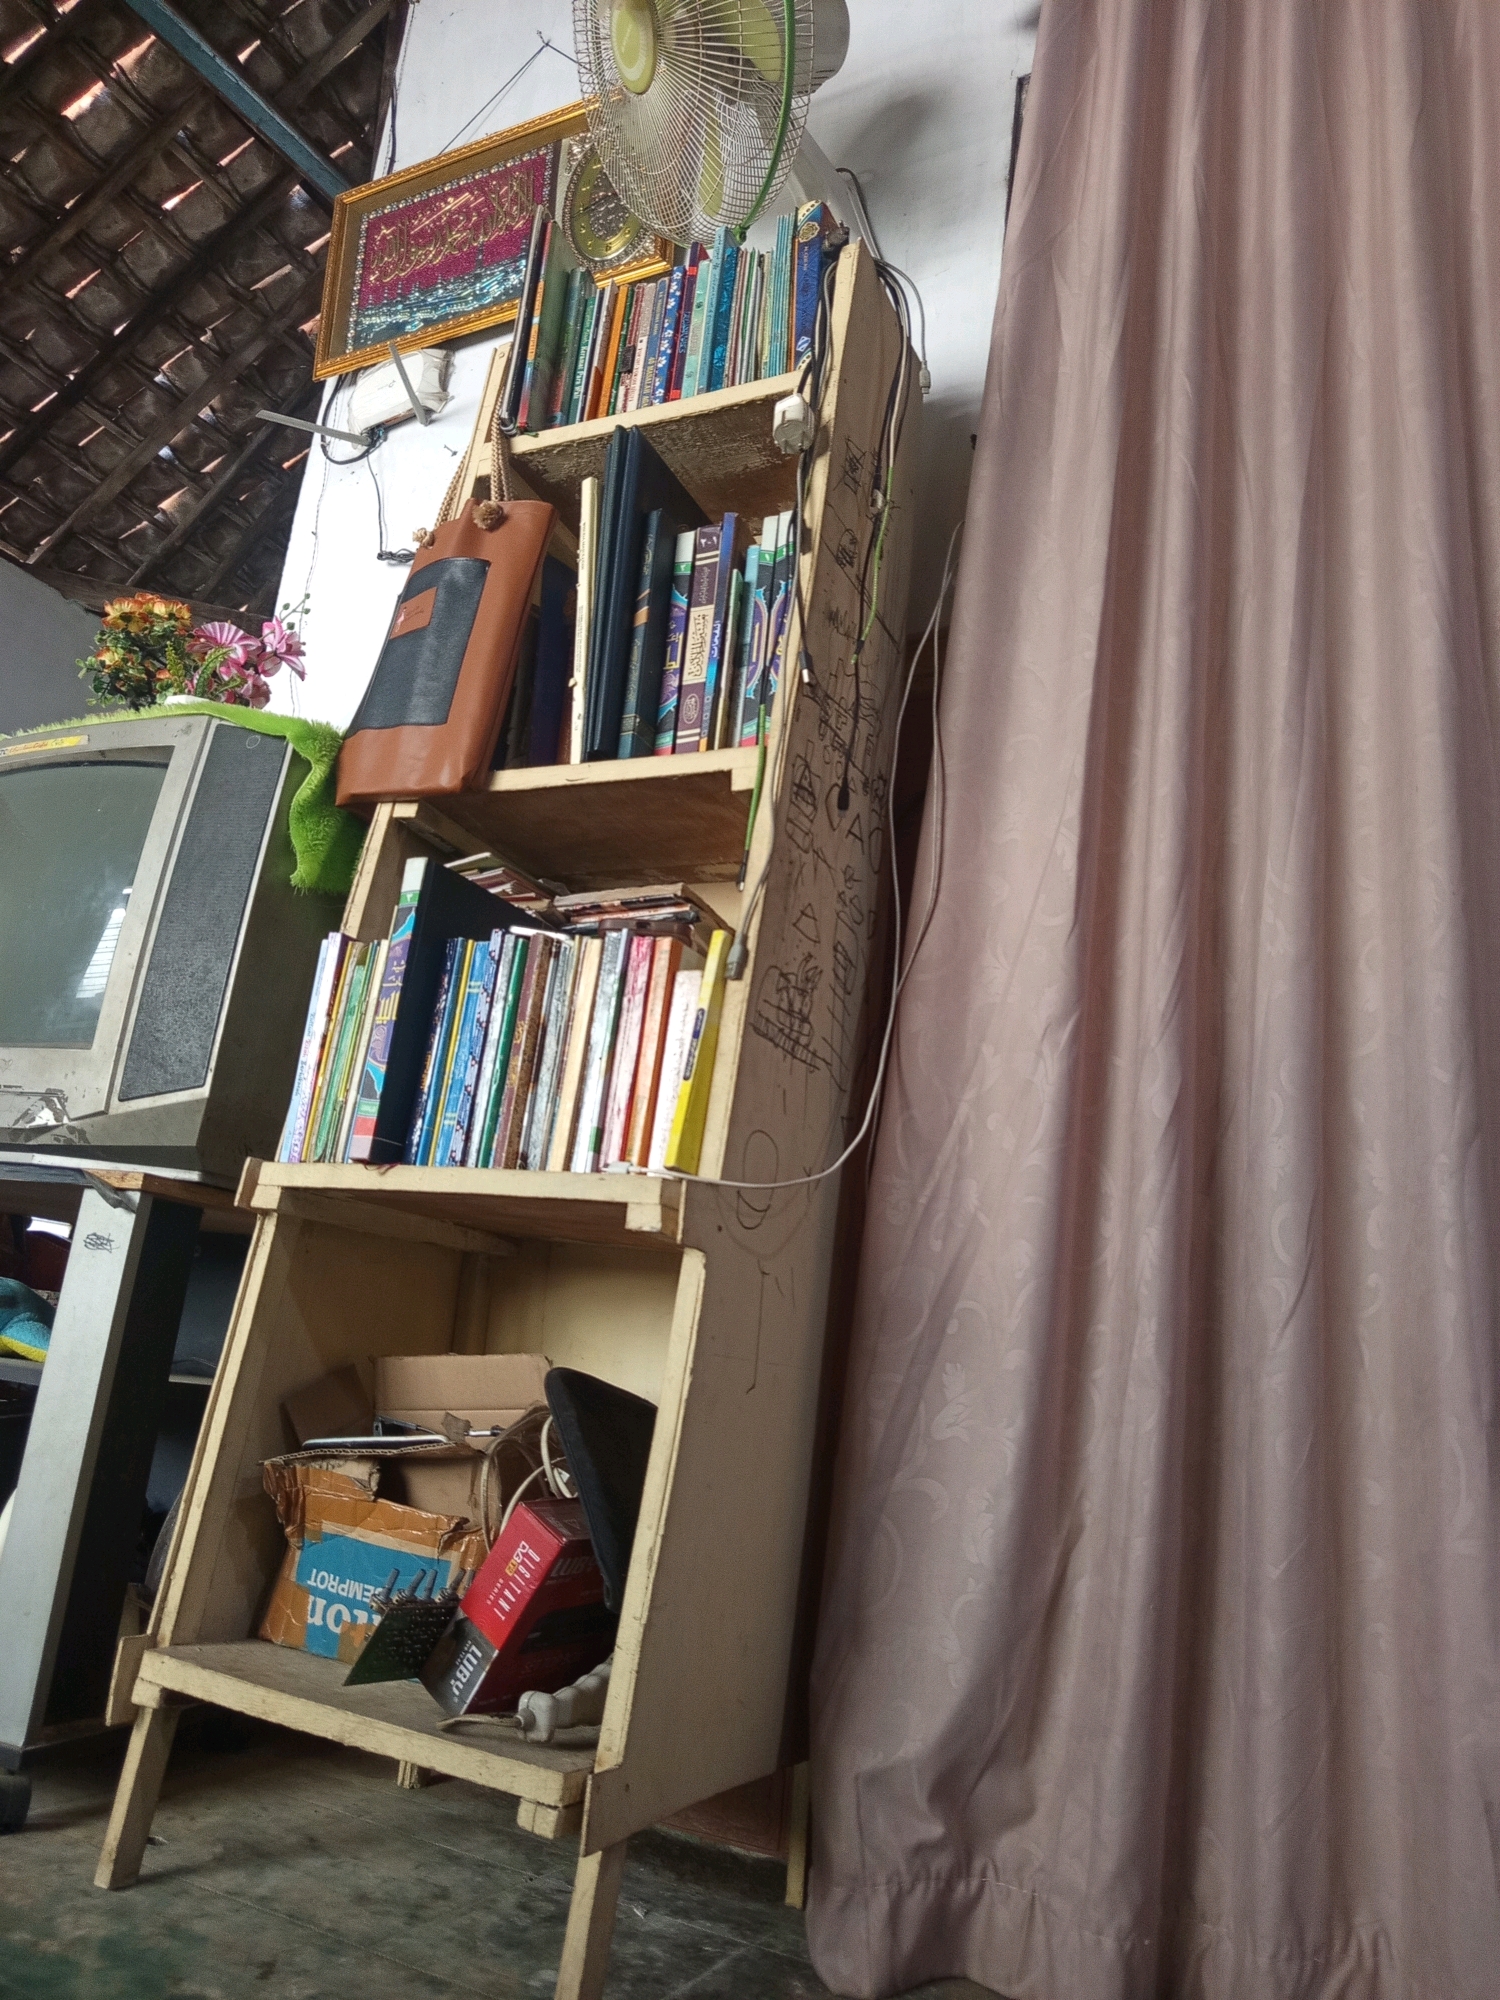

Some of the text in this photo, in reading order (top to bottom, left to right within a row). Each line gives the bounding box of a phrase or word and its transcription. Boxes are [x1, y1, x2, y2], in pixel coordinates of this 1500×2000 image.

[575, 369, 583, 385] Para
[486, 1577, 504, 1606] SERIES
[493, 1548, 541, 1621] DIGITANT
[450, 1643, 483, 1696] LUBY
